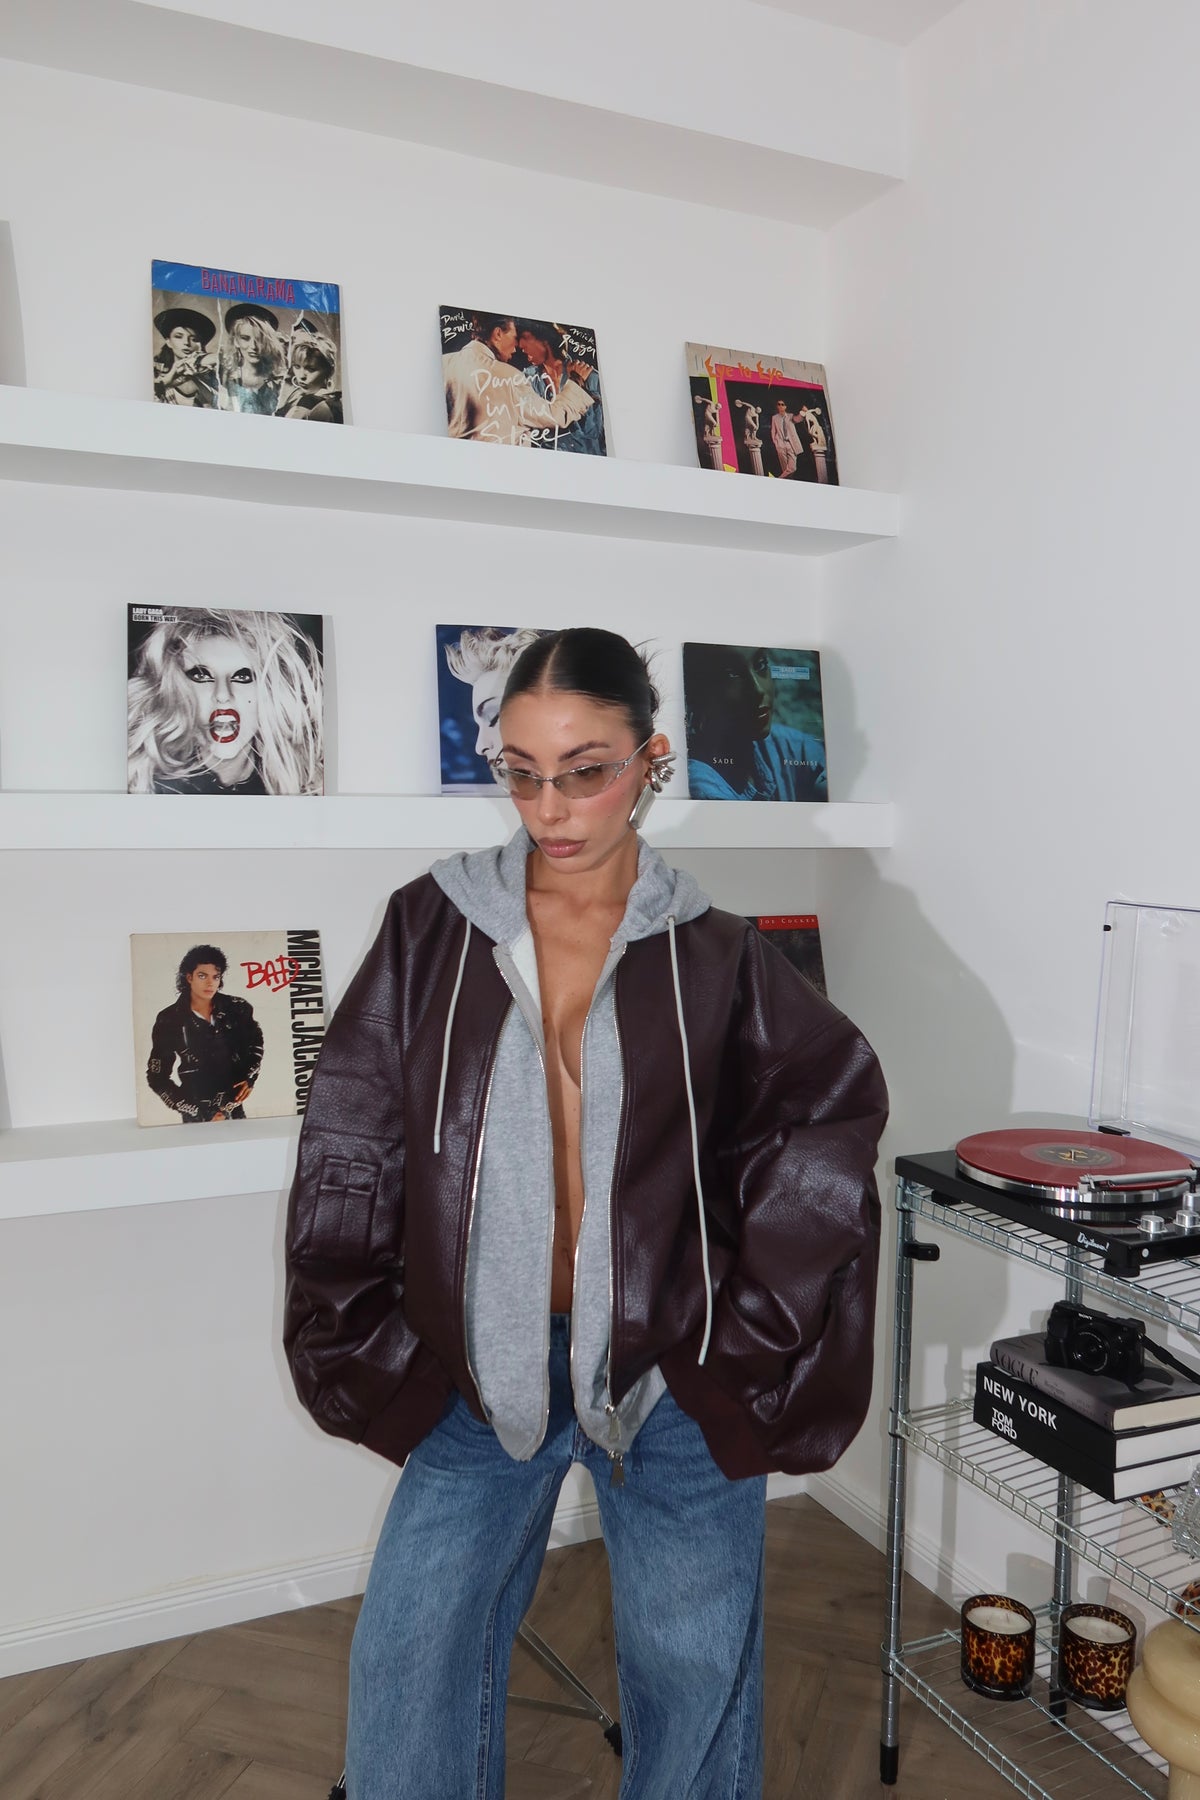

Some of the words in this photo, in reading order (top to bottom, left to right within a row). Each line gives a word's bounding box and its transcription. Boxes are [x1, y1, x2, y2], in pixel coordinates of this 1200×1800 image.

[202, 269, 295, 304] BANANARAMA
[441, 312, 465, 325] David
[442, 320, 475, 344] Bowie
[559, 334, 596, 359] Jagger
[470, 368, 557, 405] Dancing
[486, 395, 511, 421] in
[240, 955, 299, 992] BAD
[287, 930, 324, 1019] MICHAEL
[994, 1348, 1039, 1387] VOGUE
[983, 1375, 1014, 1405] NEW
[1018, 1394, 1058, 1431] YORK
[991, 1407, 1014, 1428] TOM
[991, 1417, 1018, 1440] FORD
